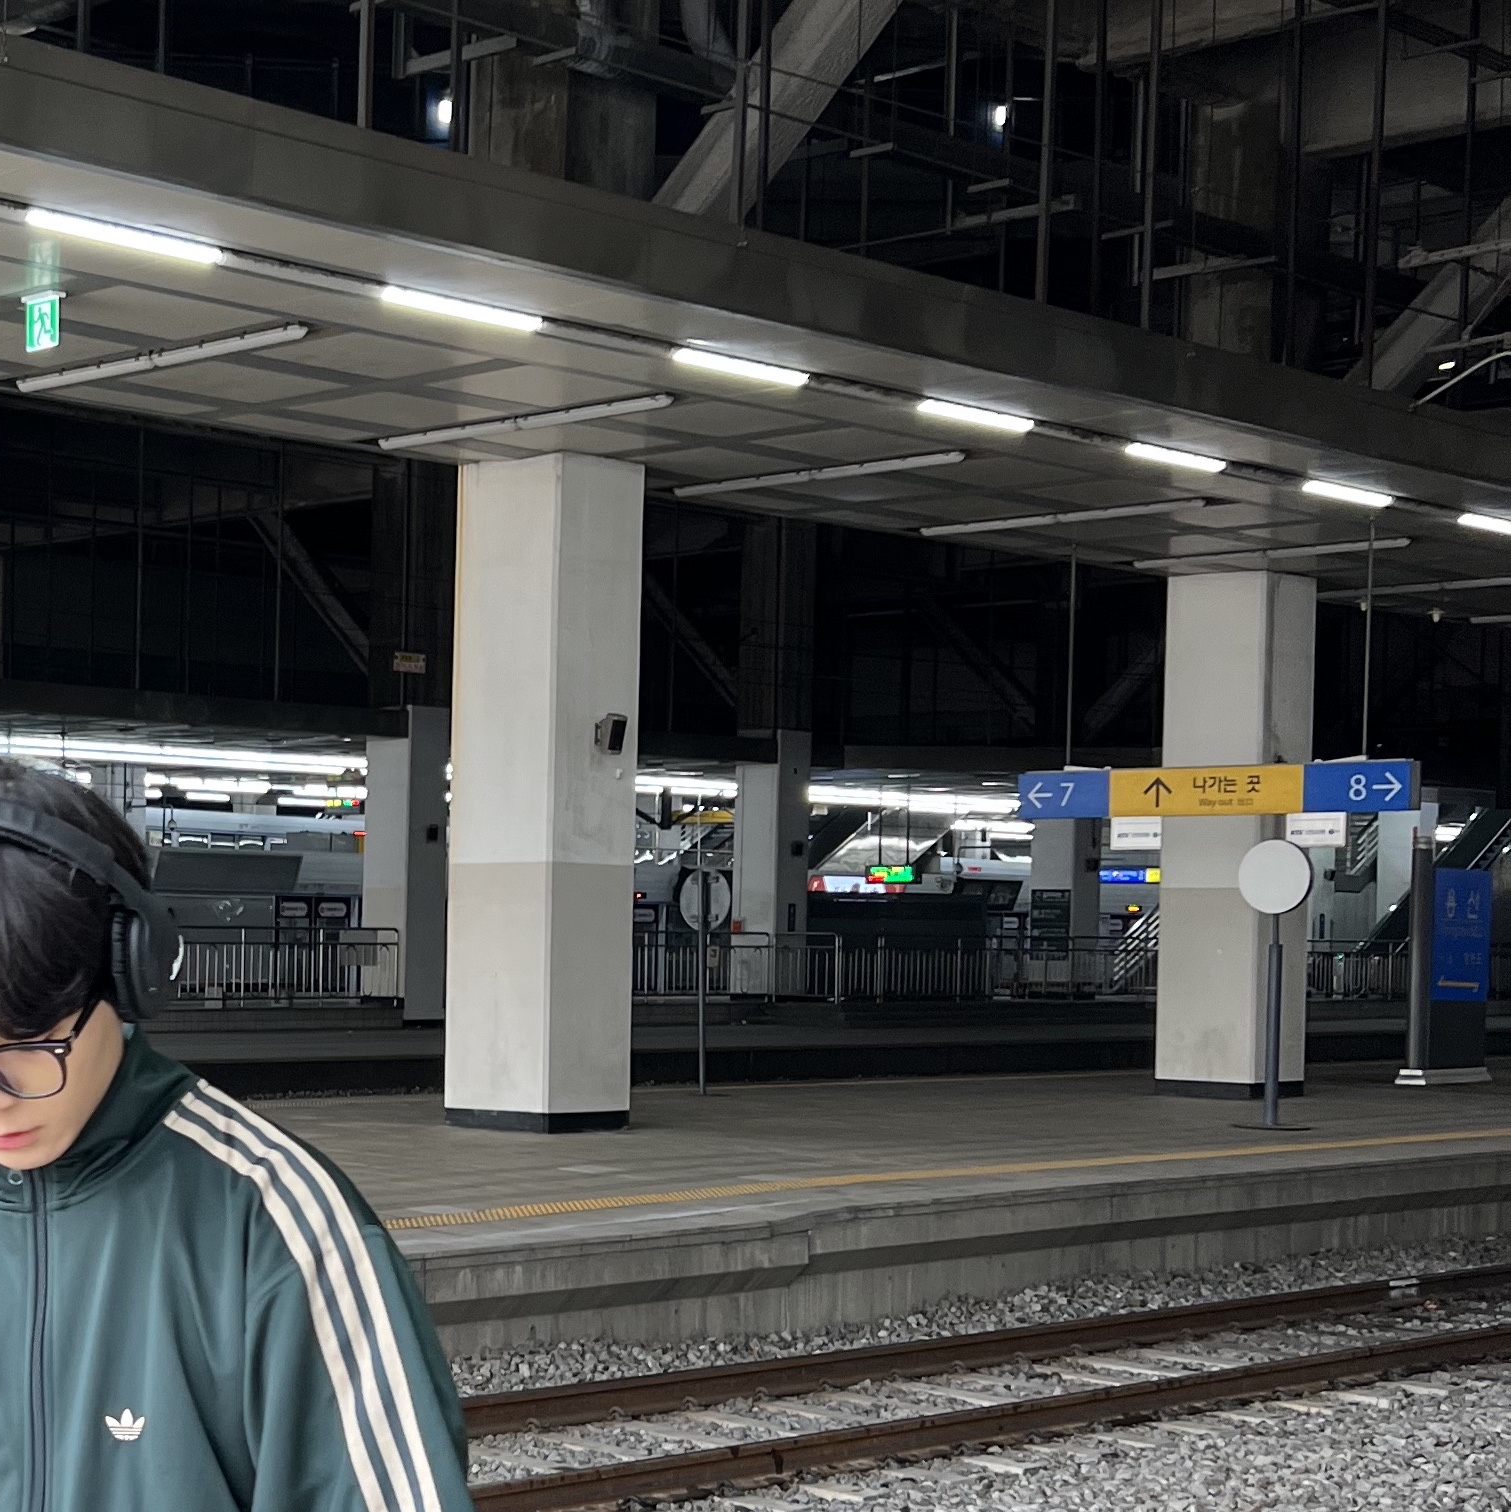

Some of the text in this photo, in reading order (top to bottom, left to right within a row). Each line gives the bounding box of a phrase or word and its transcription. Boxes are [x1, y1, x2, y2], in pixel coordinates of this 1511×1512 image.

[1060, 782, 1075, 807] 7
[1192, 774, 1261, 794] 나가는 곳
[1348, 774, 1367, 801] 8
